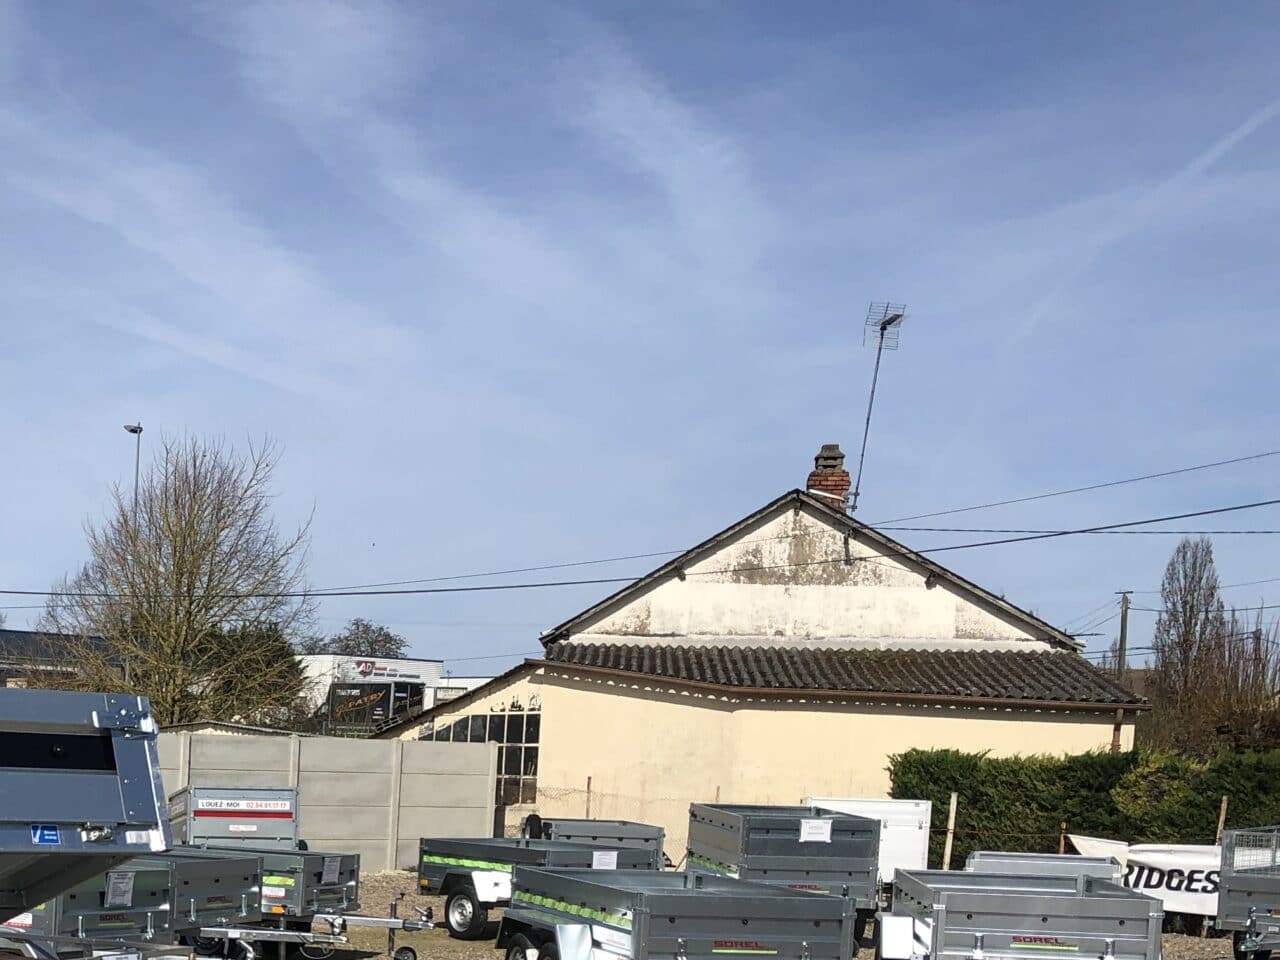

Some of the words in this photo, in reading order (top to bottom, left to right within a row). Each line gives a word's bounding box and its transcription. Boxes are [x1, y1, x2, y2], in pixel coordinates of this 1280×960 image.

[360, 662, 373, 672] AD
[713, 940, 762, 949] SOREL
[1012, 935, 1063, 945] SOREL
